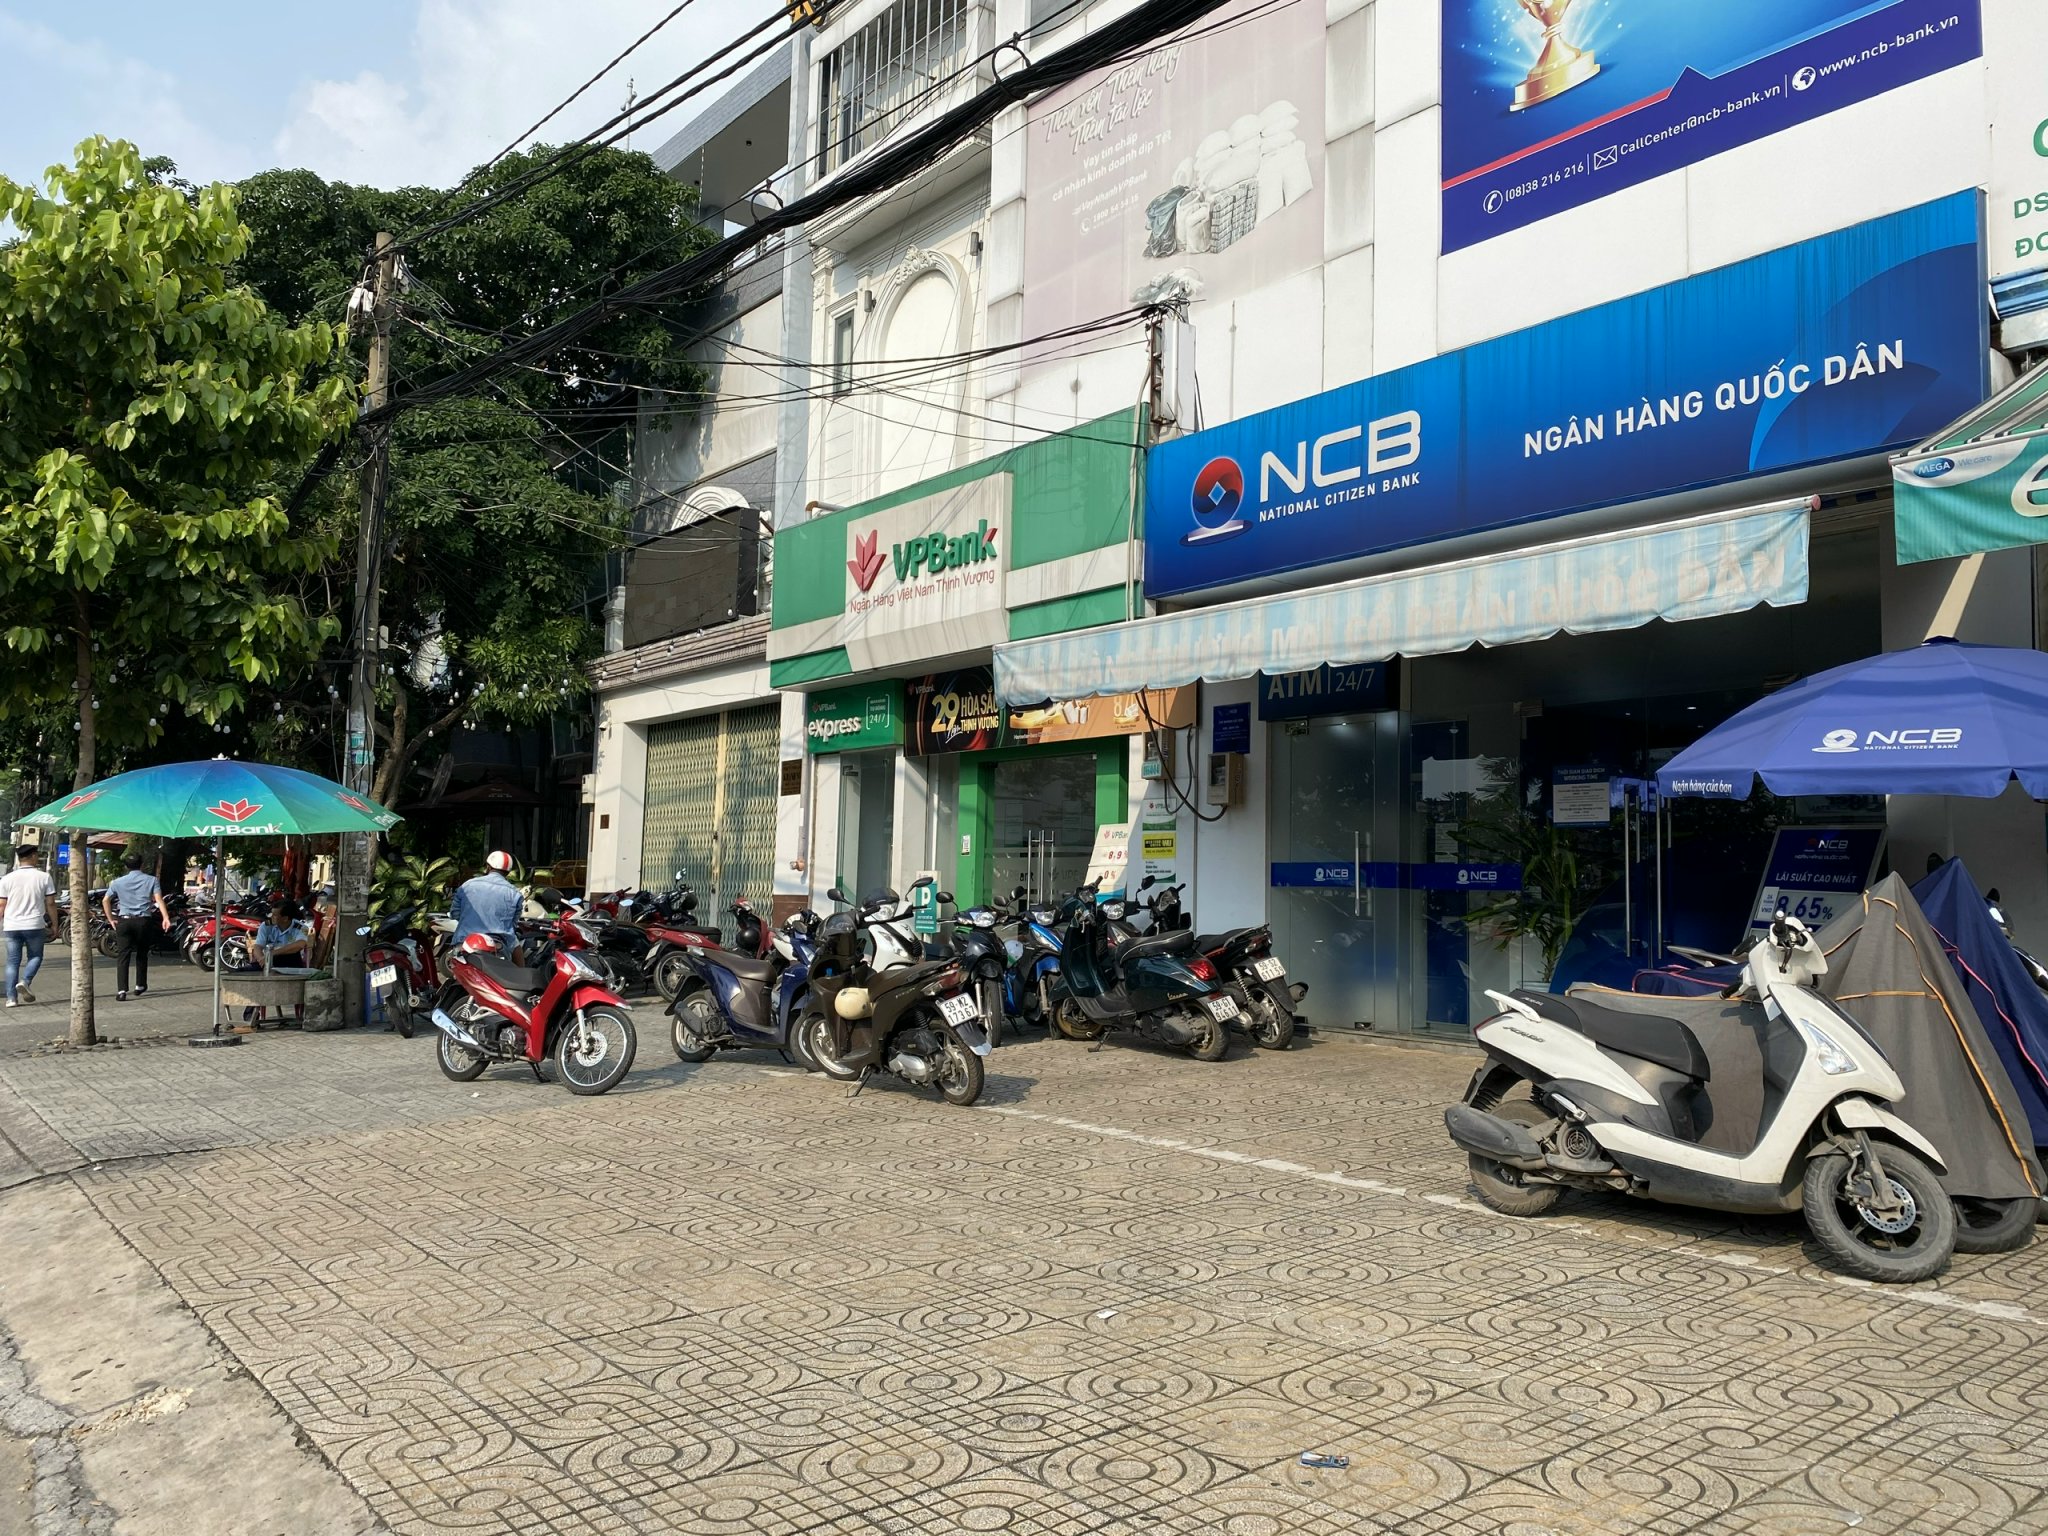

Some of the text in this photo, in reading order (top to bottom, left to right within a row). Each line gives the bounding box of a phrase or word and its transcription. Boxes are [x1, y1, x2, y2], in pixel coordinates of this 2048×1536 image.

[1819, 14, 1959, 77] www.ncb-bank.vn
[1620, 84, 1781, 155] CallCenter@ncb-bank.vn
[1505, 161, 1584, 202] (08)38 216 216
[1524, 339, 1904, 458] NGÂN HÀNG QUỐC DÂN
[1259, 410, 1422, 503] NCB
[1918, 461, 1951, 475] MEGA
[1259, 471, 1421, 523] NATIONAL CITIZEN BANK
[893, 518, 999, 583] VPBank
[1677, 543, 1787, 602] DÂN
[850, 569, 995, 615] Ngân Hàng Việt Nam Thịnh Vượng
[1267, 666, 1376, 700] ATM 24/7
[808, 715, 861, 742] eXpress
[869, 713, 886, 724] 24/7
[931, 692, 960, 734] 29
[961, 691, 980, 717] HÒA
[960, 718, 977, 734] THỊNH
[1865, 728, 1962, 745] NCB
[192, 822, 284, 836] VPBank
[1818, 839, 1849, 849] NCB
[1325, 868, 1349, 878] NCB
[1470, 871, 1498, 880] NCB
[1813, 873, 1831, 883] CAO
